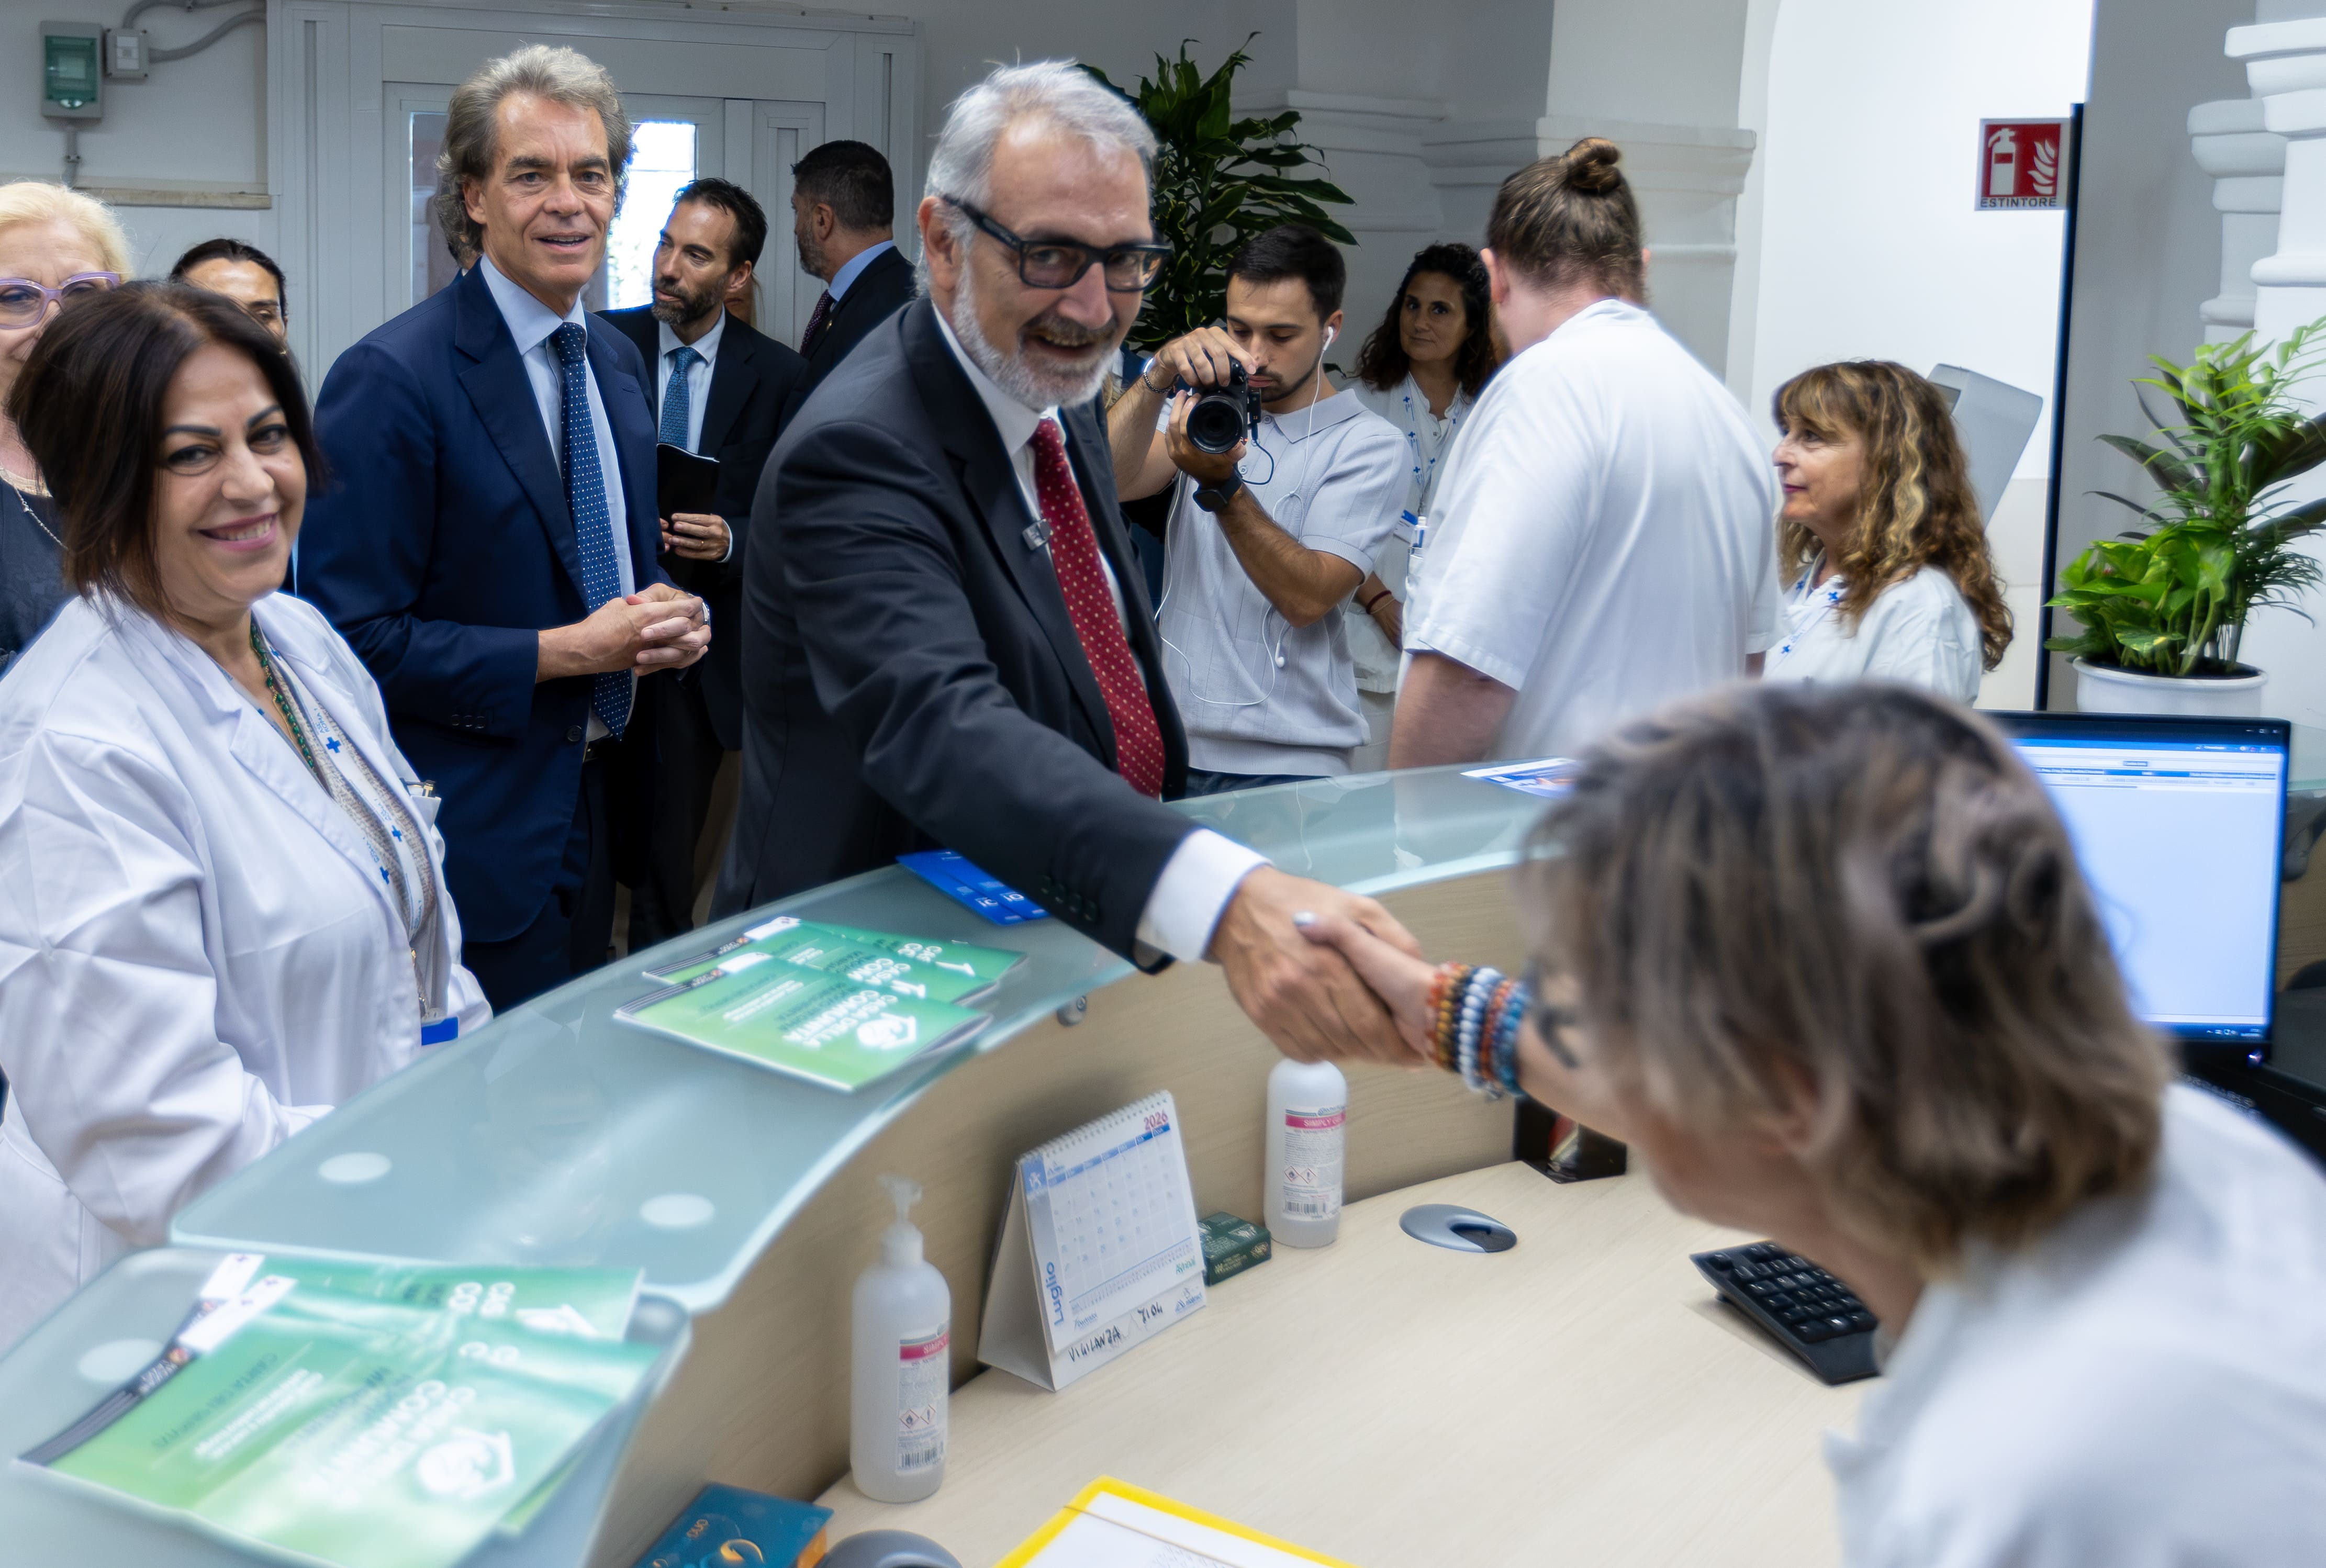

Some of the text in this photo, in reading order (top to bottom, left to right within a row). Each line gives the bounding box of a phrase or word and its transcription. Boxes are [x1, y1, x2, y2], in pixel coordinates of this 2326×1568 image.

[1980, 197, 2057, 208] ESTINTORE
[1144, 1108, 1168, 1131] 2026
[1045, 1261, 1065, 1326] Luglio
